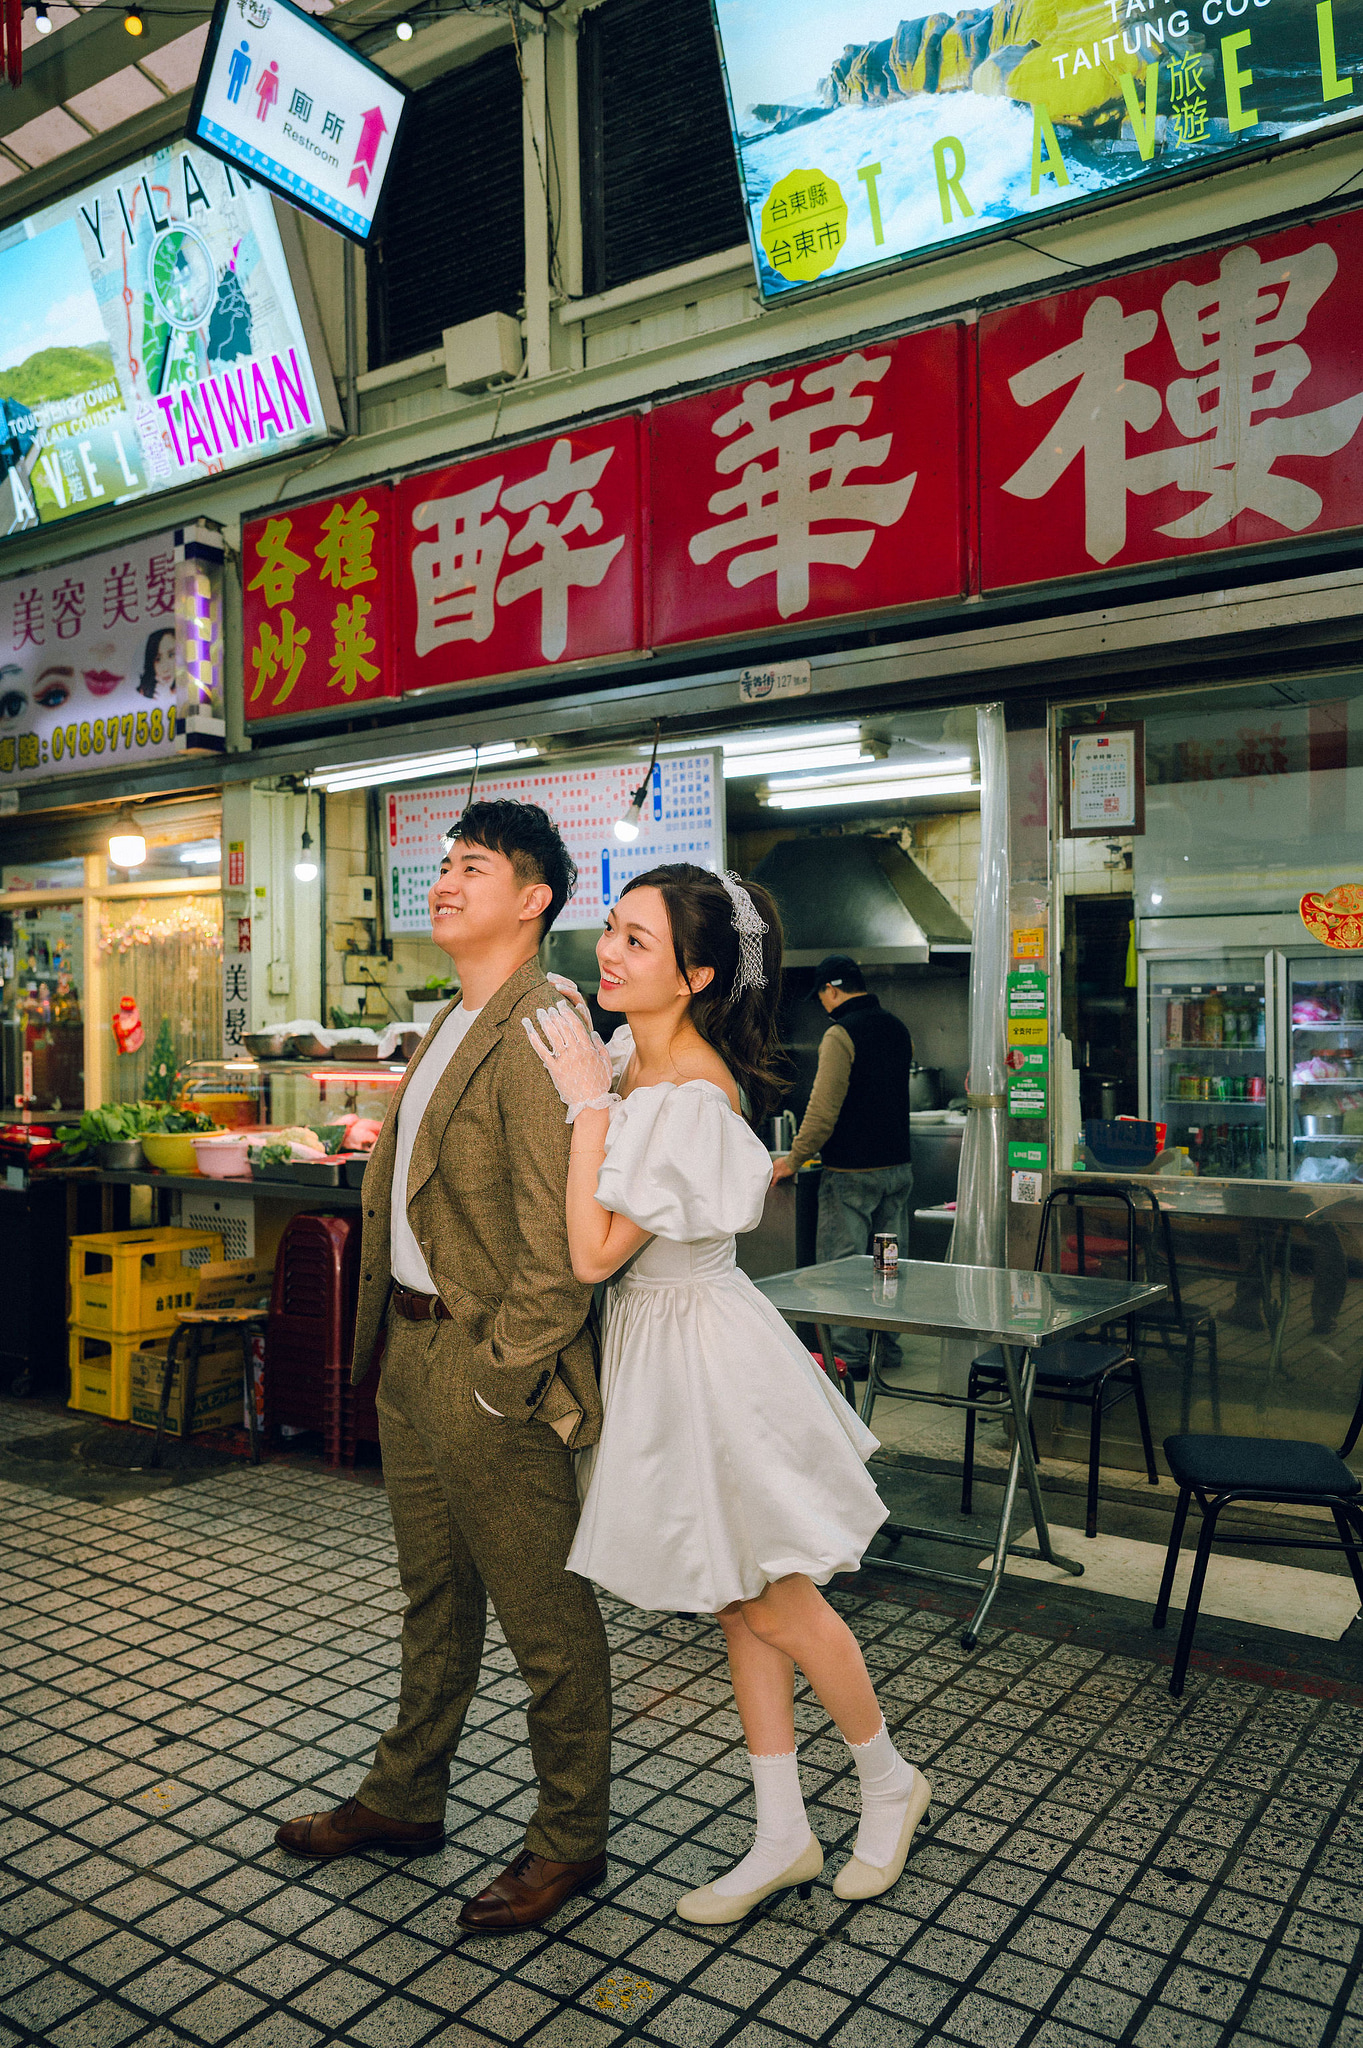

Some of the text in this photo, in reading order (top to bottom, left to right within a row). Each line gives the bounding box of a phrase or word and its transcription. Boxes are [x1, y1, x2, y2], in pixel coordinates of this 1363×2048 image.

[1052, 0, 1272, 79] TAITUNG CO
[287, 88, 346, 144] 廁所
[1166, 50, 1211, 149] 旅遊
[282, 122, 340, 168] Restroom
[769, 180, 829, 222] 台東縣
[769, 222, 842, 268] 台東市
[69, 403, 122, 437] COUNTY
[77, 381, 119, 412] TOWN
[157, 348, 312, 467] TAIWAN
[411, 242, 1363, 662] 醉華樓
[247, 497, 380, 609] 各種
[12, 578, 87, 652] 美容
[250, 594, 382, 706] 炒菜
[777, 674, 792, 688] 127
[225, 963, 248, 1047] 美髮
